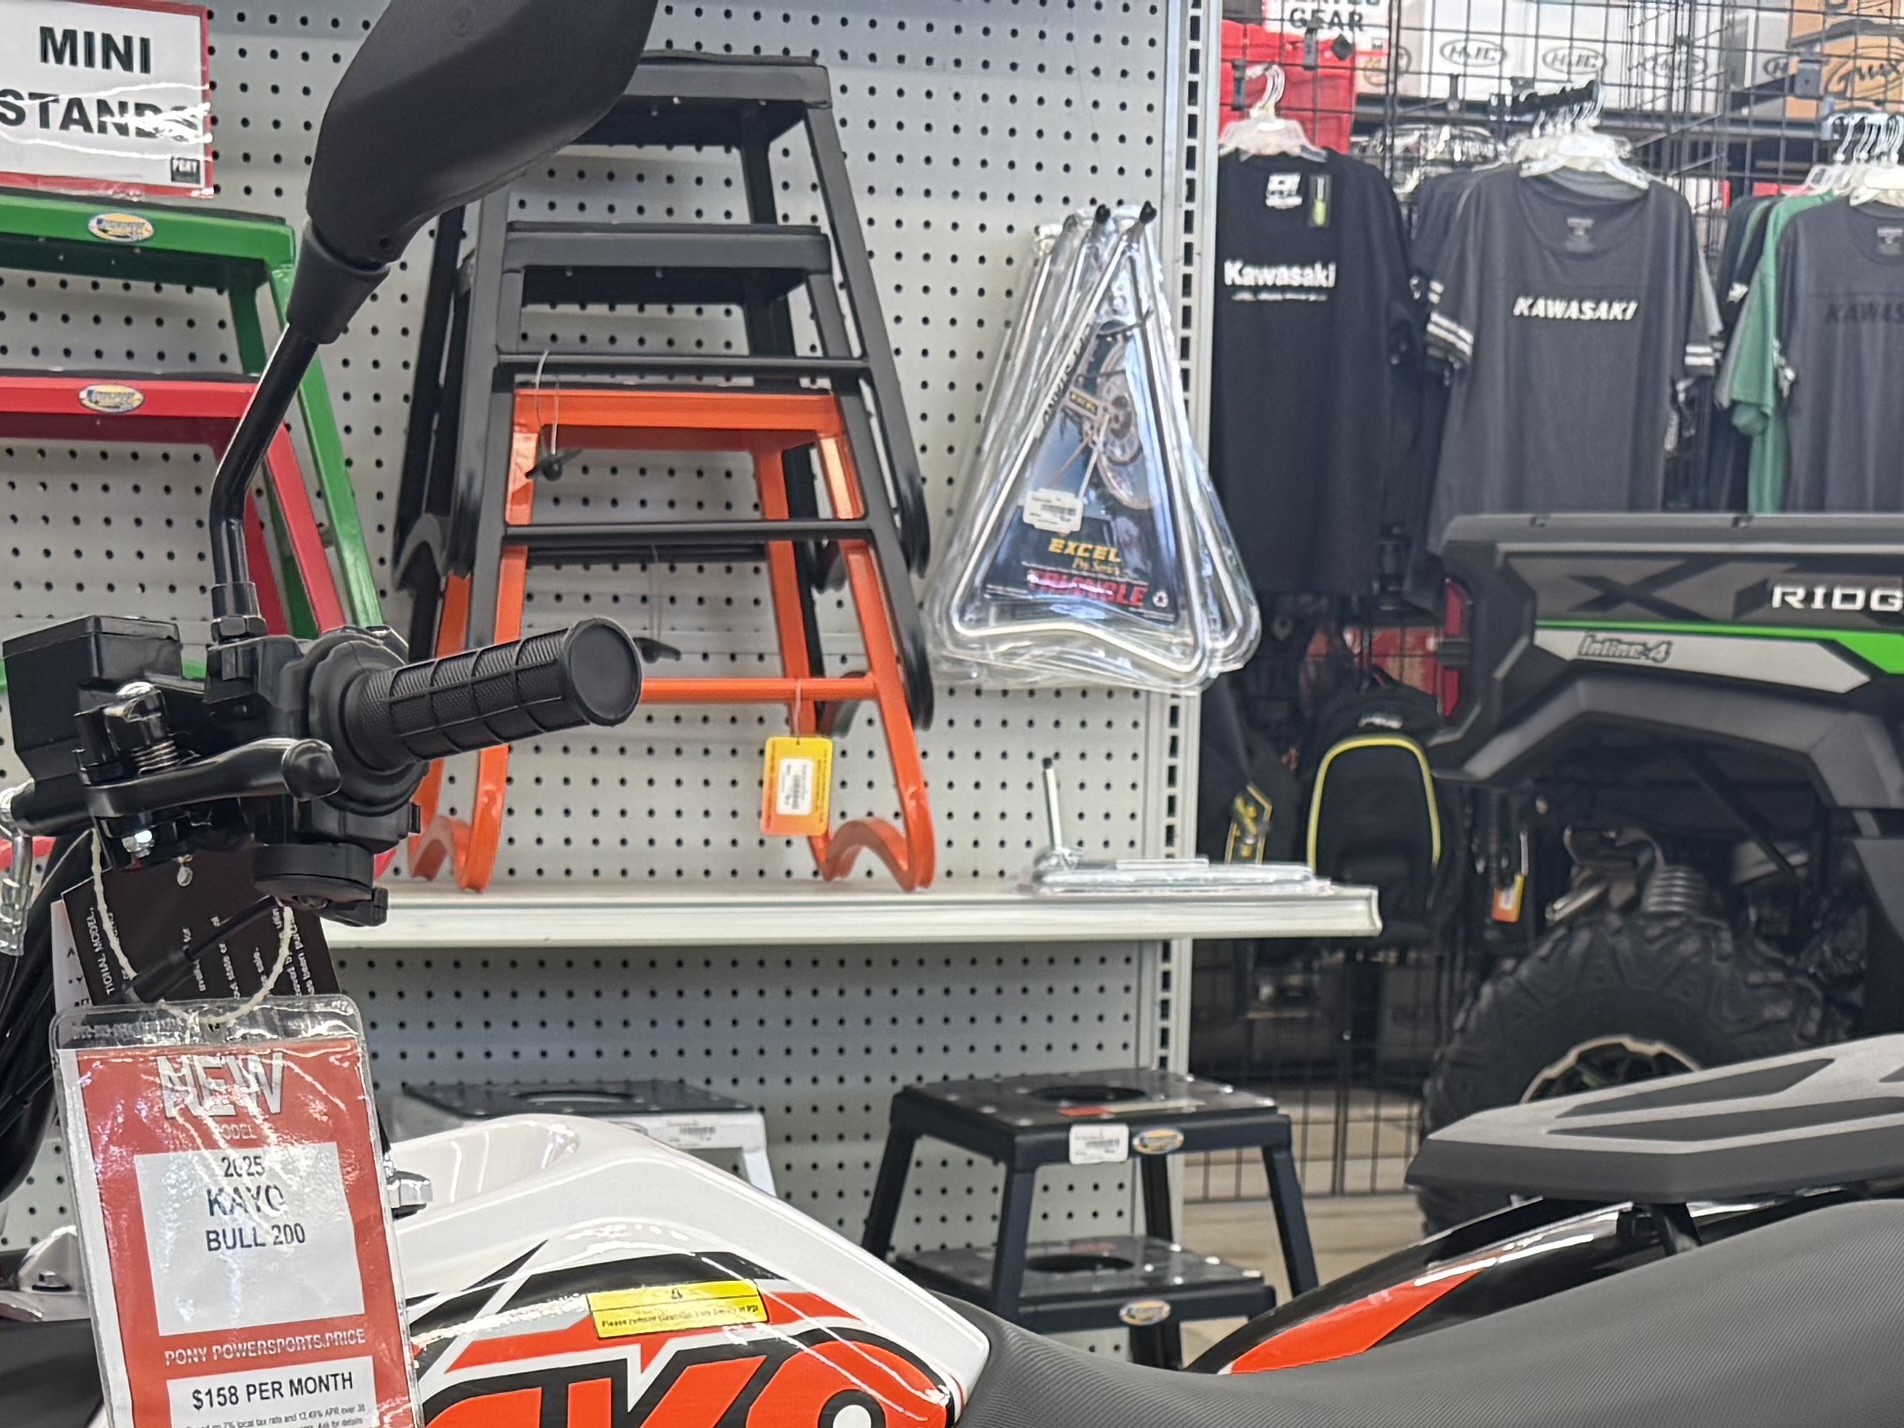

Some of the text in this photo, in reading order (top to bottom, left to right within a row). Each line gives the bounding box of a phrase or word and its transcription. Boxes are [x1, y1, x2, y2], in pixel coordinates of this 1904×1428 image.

[1289, 7, 1364, 33] GEAR
[38, 26, 151, 75] MINI
[1224, 261, 1336, 288] Kawasaki
[1513, 297, 1638, 321] KAWASAKI
[1048, 538, 1122, 562] EXCEL
[157, 1052, 284, 1118] NEW
[213, 1122, 258, 1141] ODEL
[206, 1184, 286, 1218] KAYO
[205, 1222, 306, 1252] BULL 200
[164, 1347, 207, 1366] PONY
[192, 1371, 354, 1411] $158 PER MONTH
